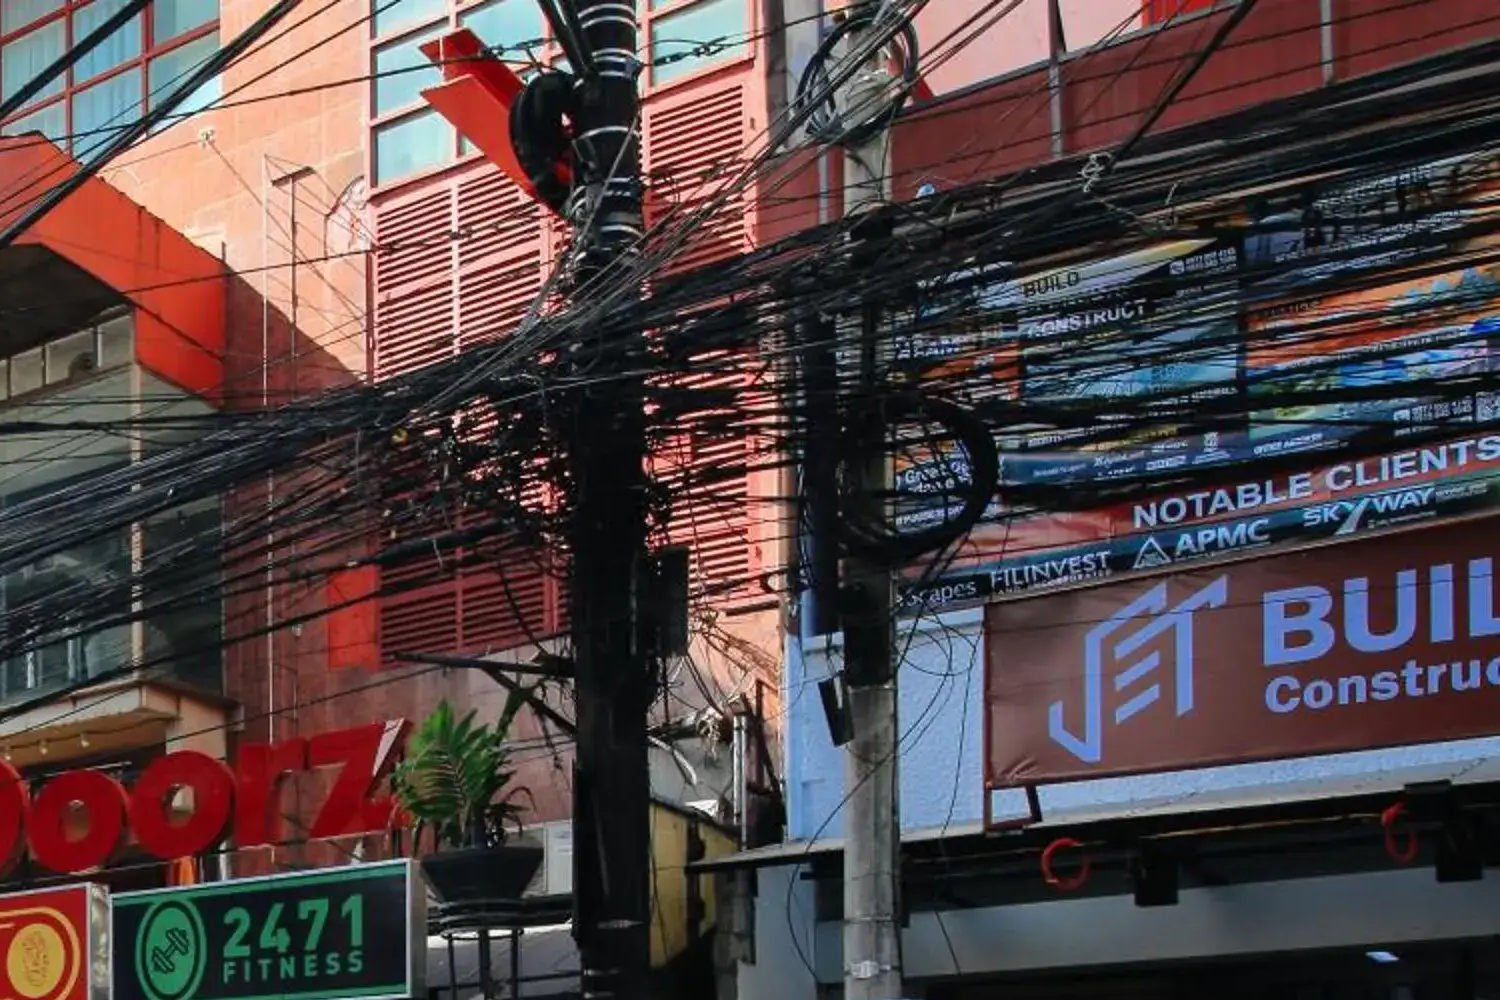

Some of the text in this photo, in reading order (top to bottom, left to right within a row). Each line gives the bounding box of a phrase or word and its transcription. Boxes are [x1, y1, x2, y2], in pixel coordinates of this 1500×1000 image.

[1133, 435, 1500, 528] NOTABLE CLIENTS
[1175, 519, 1270, 555] APMC
[223, 894, 364, 958] 2471
[223, 951, 364, 984] FITNESS
